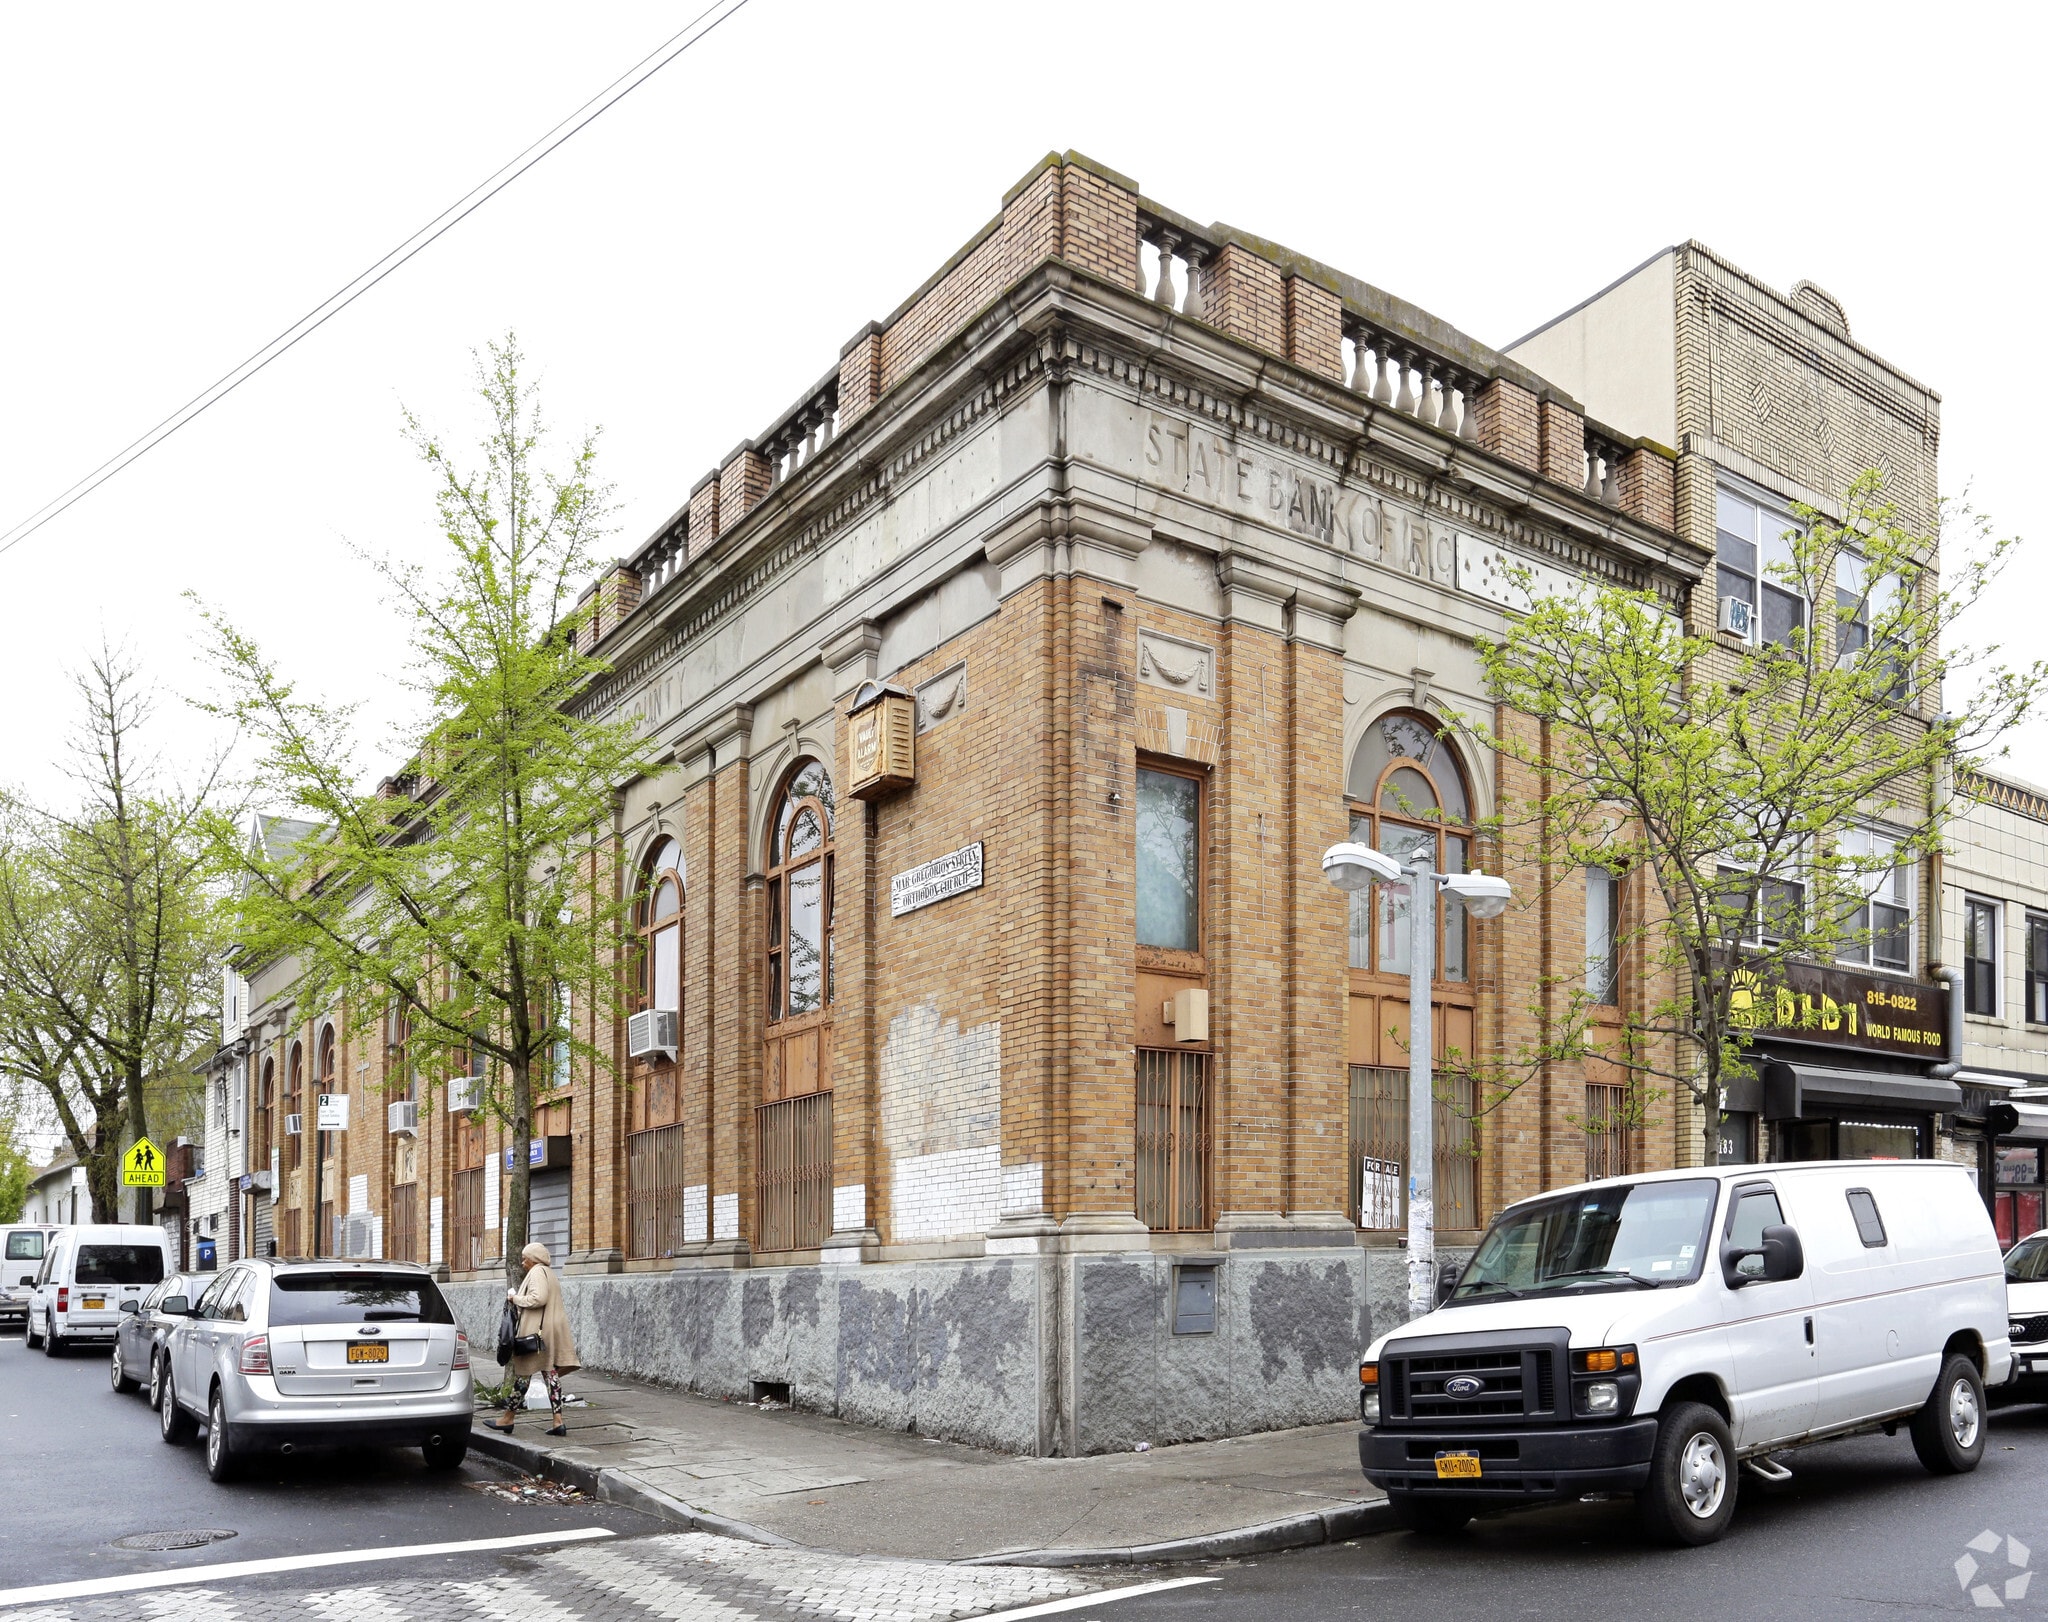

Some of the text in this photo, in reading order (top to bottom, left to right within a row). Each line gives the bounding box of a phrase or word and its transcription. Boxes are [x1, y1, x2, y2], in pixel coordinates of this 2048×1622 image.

[1145, 424, 1253, 502] STATE
[1269, 470, 1348, 539] BANK
[1362, 507, 1397, 552] OF
[857, 741, 877, 759] ALARM
[896, 876, 911, 890] MAR
[902, 872, 969, 906] ORTHODOX CHURCH
[1867, 990, 1917, 1011] 815-0822
[1866, 1022, 1941, 1046] WORLD FAMOUS FOOD
[321, 1096, 327, 1106] 2
[1718, 1139, 1733, 1155] 183
[1366, 1160, 1399, 1176] FOR AE
[128, 1173, 160, 1184] AHEAD
[204, 1249, 211, 1259] P
[1452, 1381, 1471, 1392] Ford
